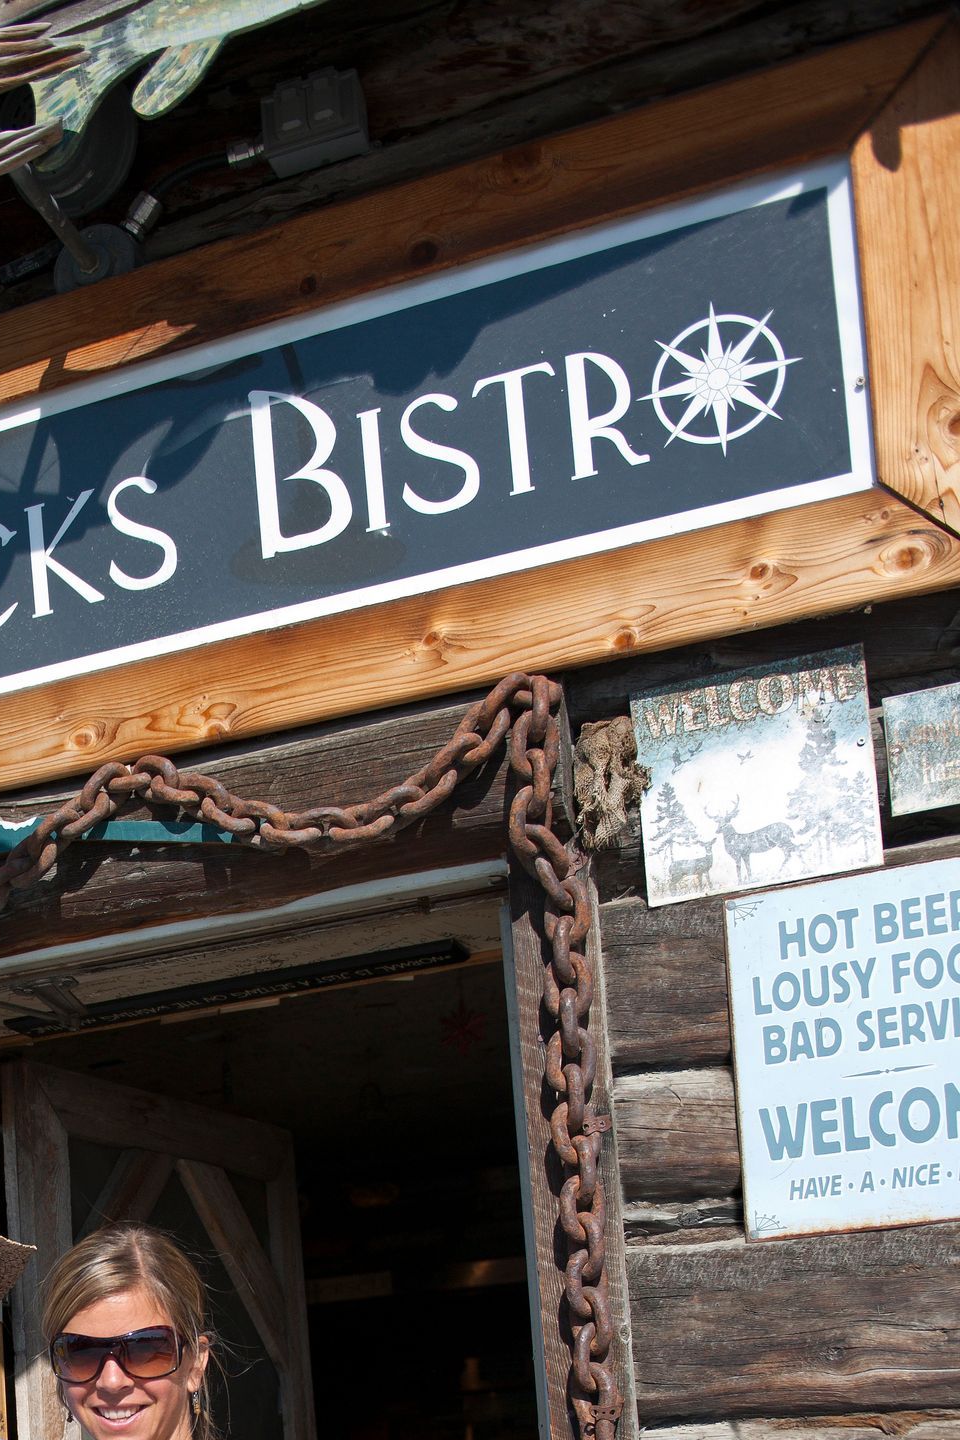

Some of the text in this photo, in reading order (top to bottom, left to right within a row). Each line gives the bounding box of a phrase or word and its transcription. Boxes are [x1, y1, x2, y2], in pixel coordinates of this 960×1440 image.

[645, 662, 864, 740] WELCOME
[778, 908, 859, 960] HOT
[751, 957, 876, 1015] LOUSY
[762, 997, 960, 1065] BAD SERVI
[790, 1163, 940, 1200] HAVE A NICE
